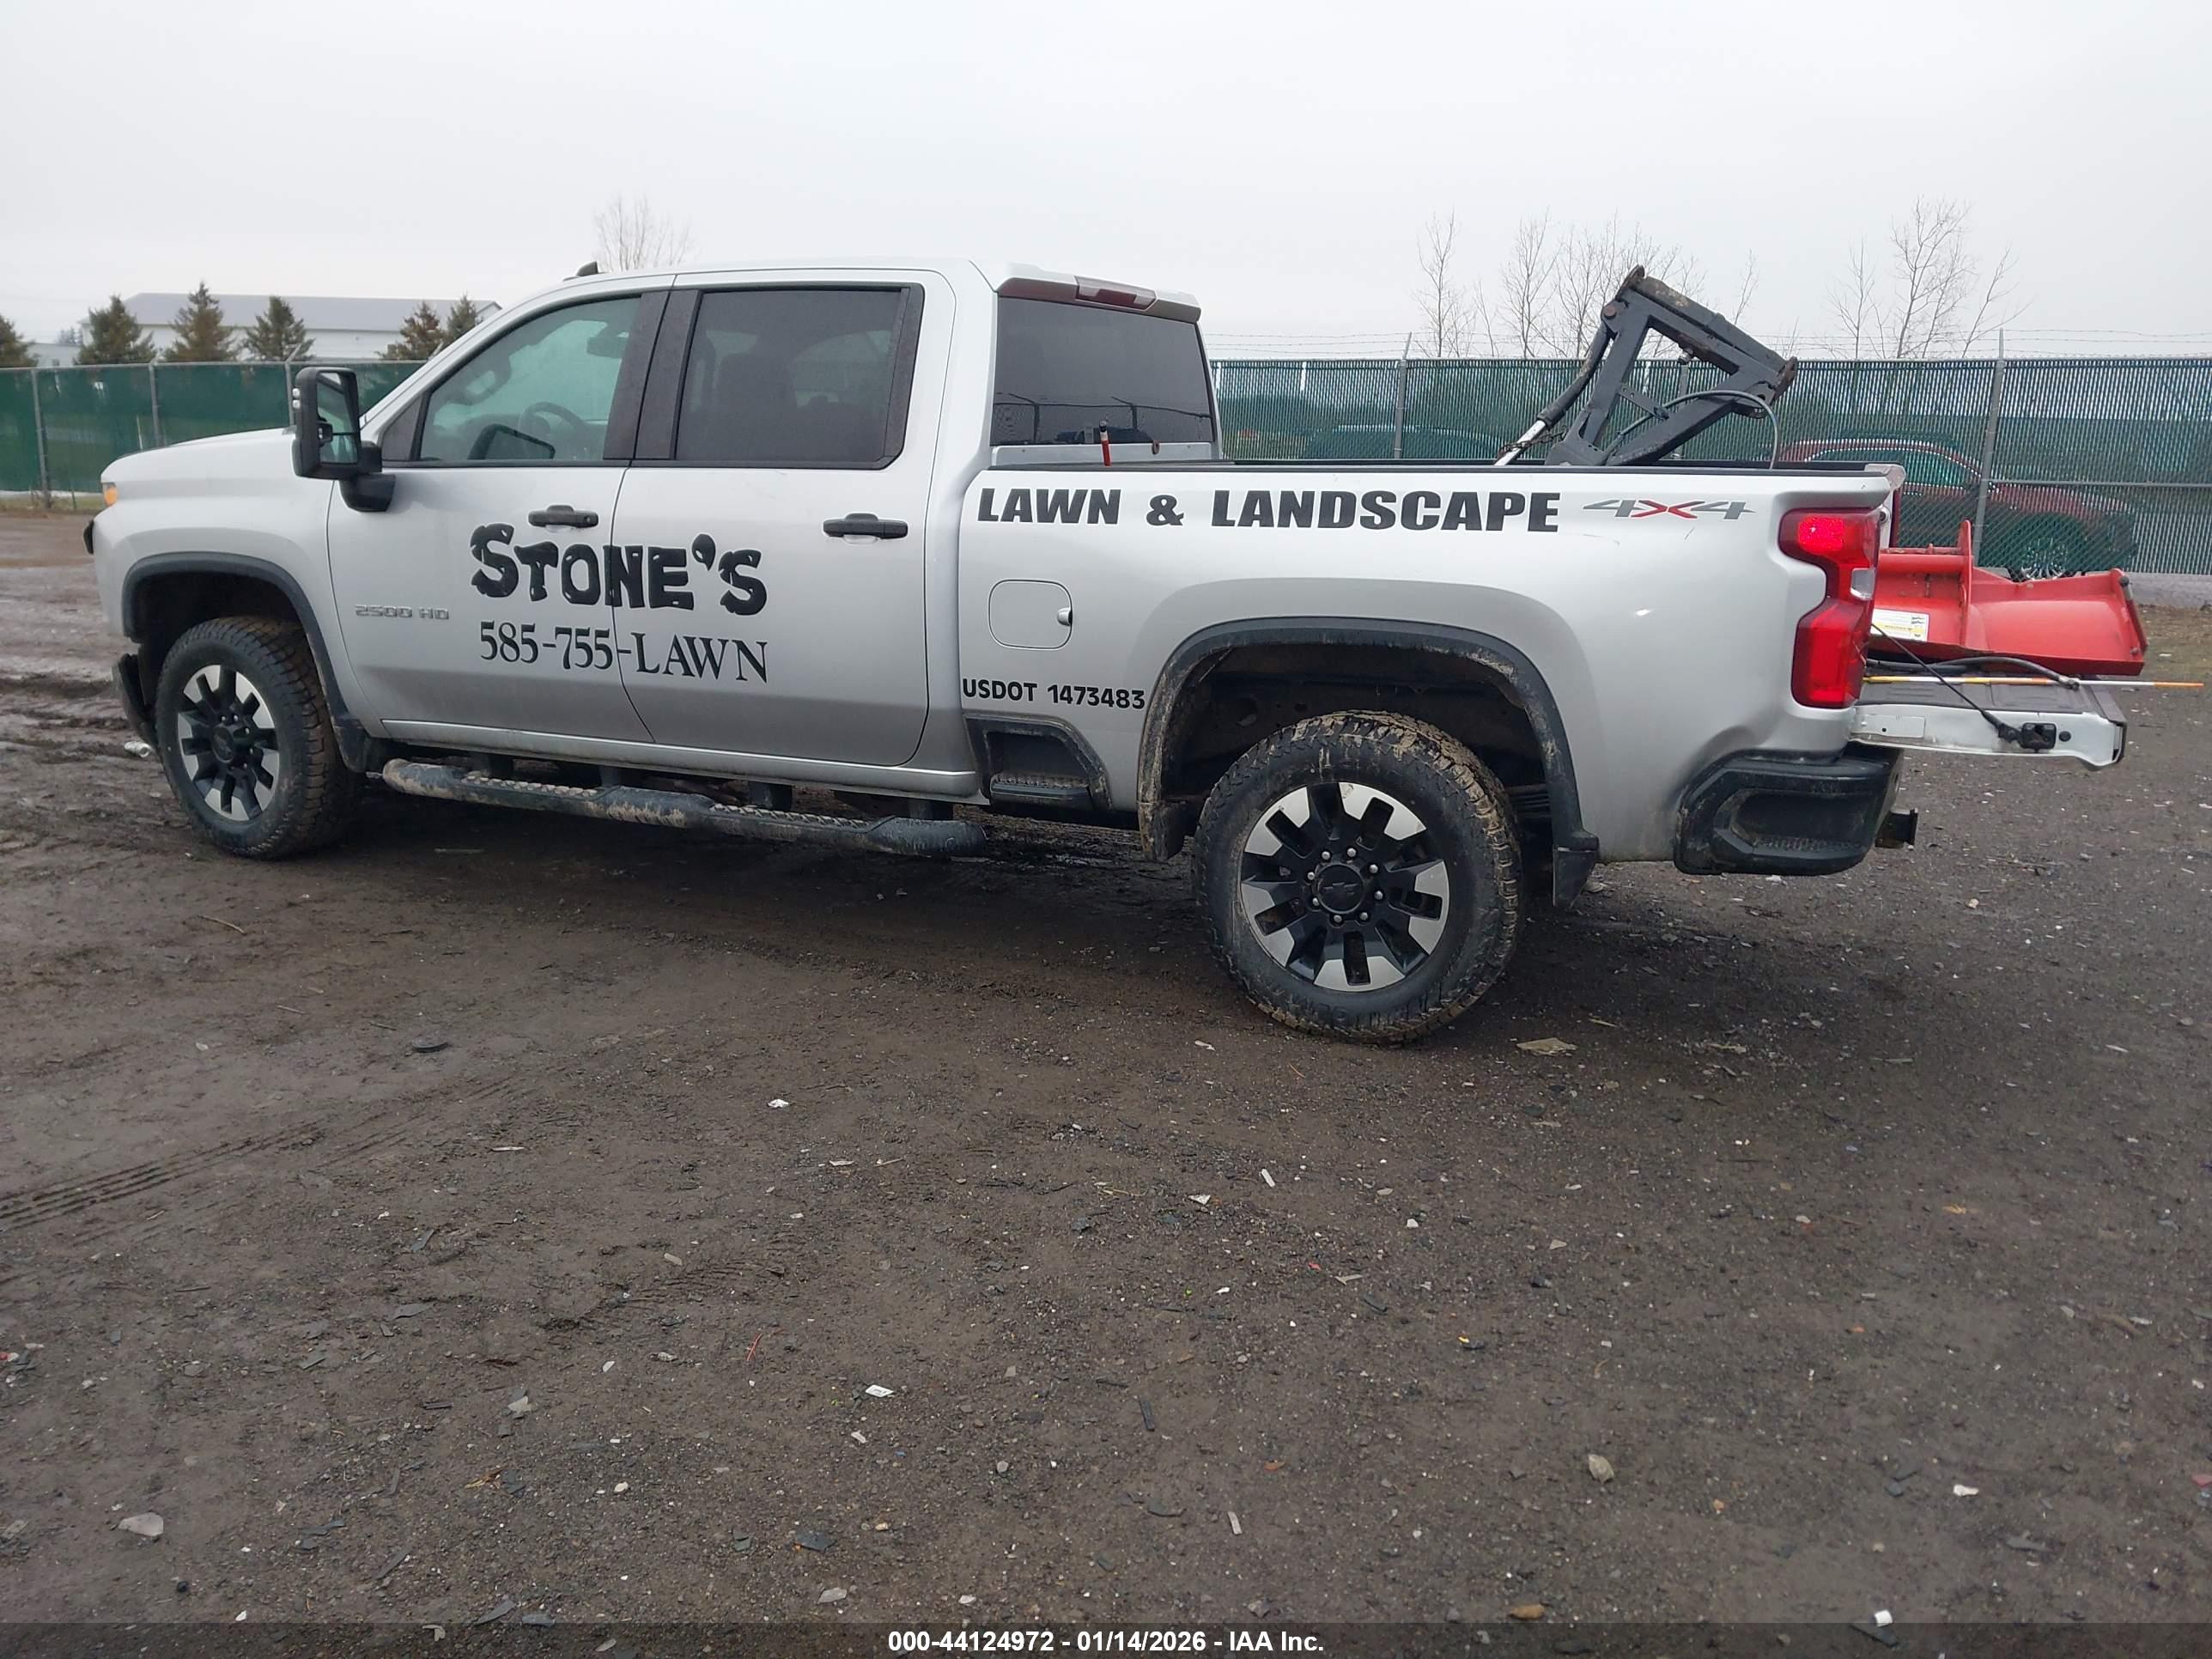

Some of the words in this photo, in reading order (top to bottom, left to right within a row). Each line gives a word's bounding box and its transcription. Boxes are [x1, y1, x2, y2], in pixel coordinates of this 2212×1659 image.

[978, 488, 1121, 525] LAWN
[1146, 495, 1184, 526] &
[1212, 489, 1560, 532] LANDSCAPE
[471, 523, 768, 616] STONE'S
[355, 605, 413, 618] 2500
[418, 607, 449, 620] HD
[480, 621, 769, 684] 585-755-LAWN
[963, 678, 1037, 702] USDOT
[1047, 684, 1146, 709] 1473483
